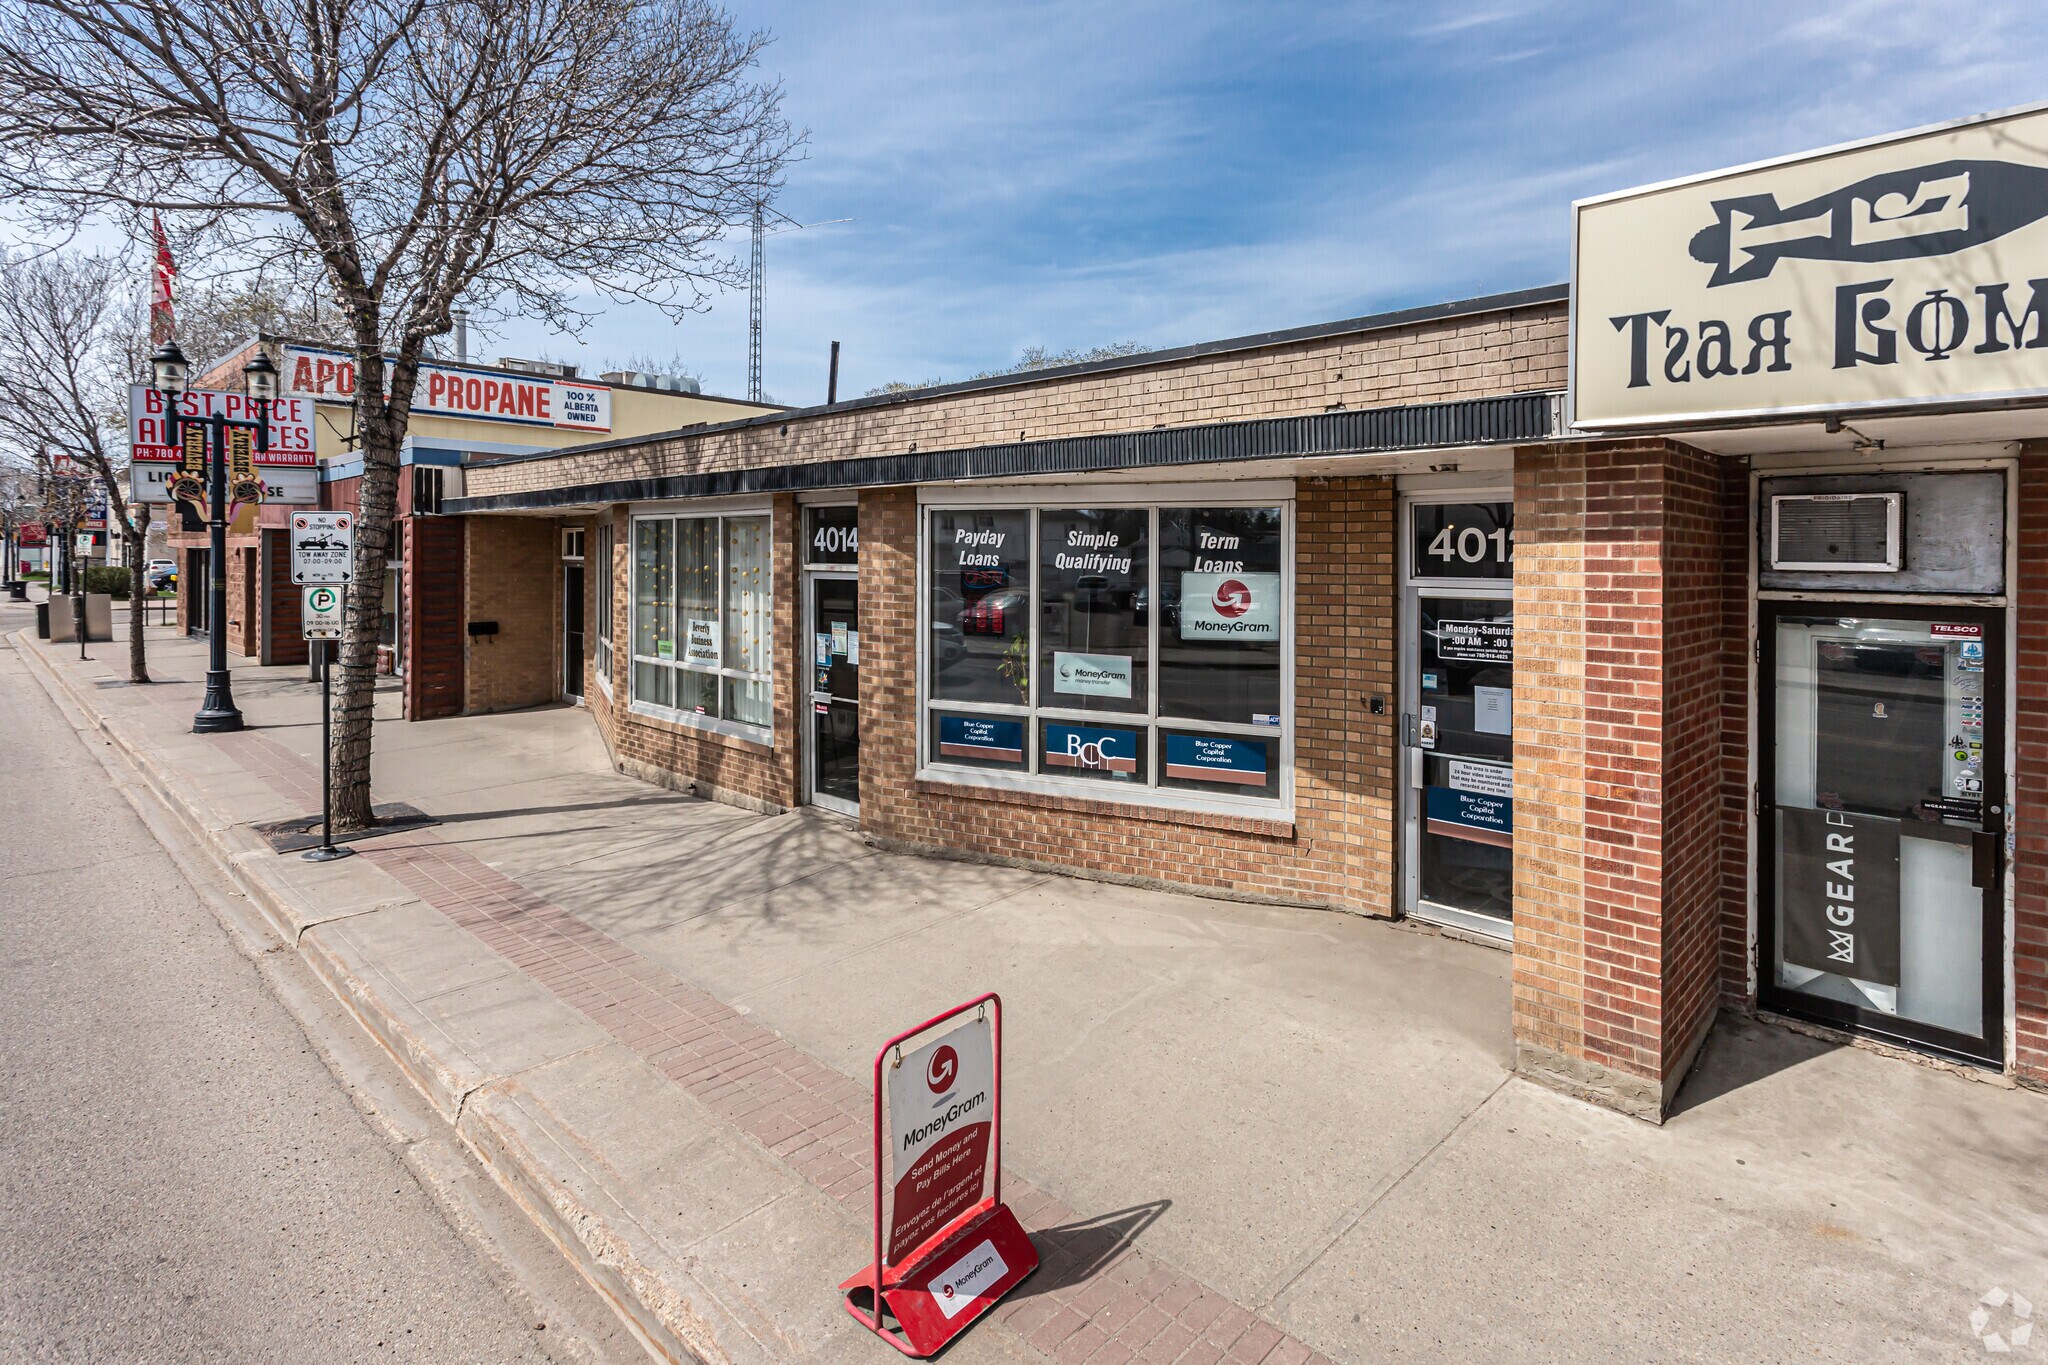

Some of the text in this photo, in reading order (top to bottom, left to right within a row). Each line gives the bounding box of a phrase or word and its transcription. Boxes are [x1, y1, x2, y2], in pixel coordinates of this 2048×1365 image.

[429, 372, 550, 418] PROPANE
[566, 391, 596, 402] 100 %
[145, 389, 215, 417] BST
[564, 401, 599, 413] ALBERTA
[567, 412, 596, 422] OWNED
[136, 447, 153, 458] PH:
[155, 448, 173, 458] 780
[185, 427, 203, 471] BEVERLY
[233, 431, 249, 473] BEVERLY
[268, 453, 314, 463] WARRANTY
[814, 526, 858, 552] 4014
[955, 528, 1005, 548] Payday
[1067, 530, 1119, 550] Simple
[1200, 532, 1240, 550] Term
[1428, 527, 1513, 563] 401
[958, 550, 1000, 567] Loans
[1055, 552, 1131, 574] Qualifying
[1193, 556, 1244, 573] Loans
[318, 594, 330, 606] P
[692, 621, 711, 635] Beverly
[1194, 620, 1270, 634] MoneyGram
[1445, 624, 1513, 635] Monday-Saturda
[1934, 625, 1978, 633] TELSCO
[691, 634, 713, 647] Business
[1467, 637, 1481, 646] AM
[688, 646, 718, 660] Association
[1075, 668, 1126, 680] MoneyGram
[963, 720, 975, 728] Blue
[964, 733, 994, 742] Corporation
[1202, 747, 1225, 756] Capital
[1209, 741, 1232, 749] Copper
[1196, 754, 1232, 763] Corporation
[1477, 779, 1500, 787] monitored
[1484, 774, 1513, 782] surveillance
[1460, 782, 1480, 790] recorded
[1460, 794, 1504, 808] Blue Copper
[1469, 804, 1495, 815] Capital
[1461, 811, 1503, 824] Corporation
[903, 1091, 985, 1151] MoneyGram
[911, 1127, 978, 1180] Send Money and
[916, 1147, 972, 1193] Pay Bills Here
[895, 1165, 982, 1238] Envoyez de l'argent et
[893, 1179, 979, 1254] payez vos factures ici
[955, 1256, 994, 1289] MoneyGram
